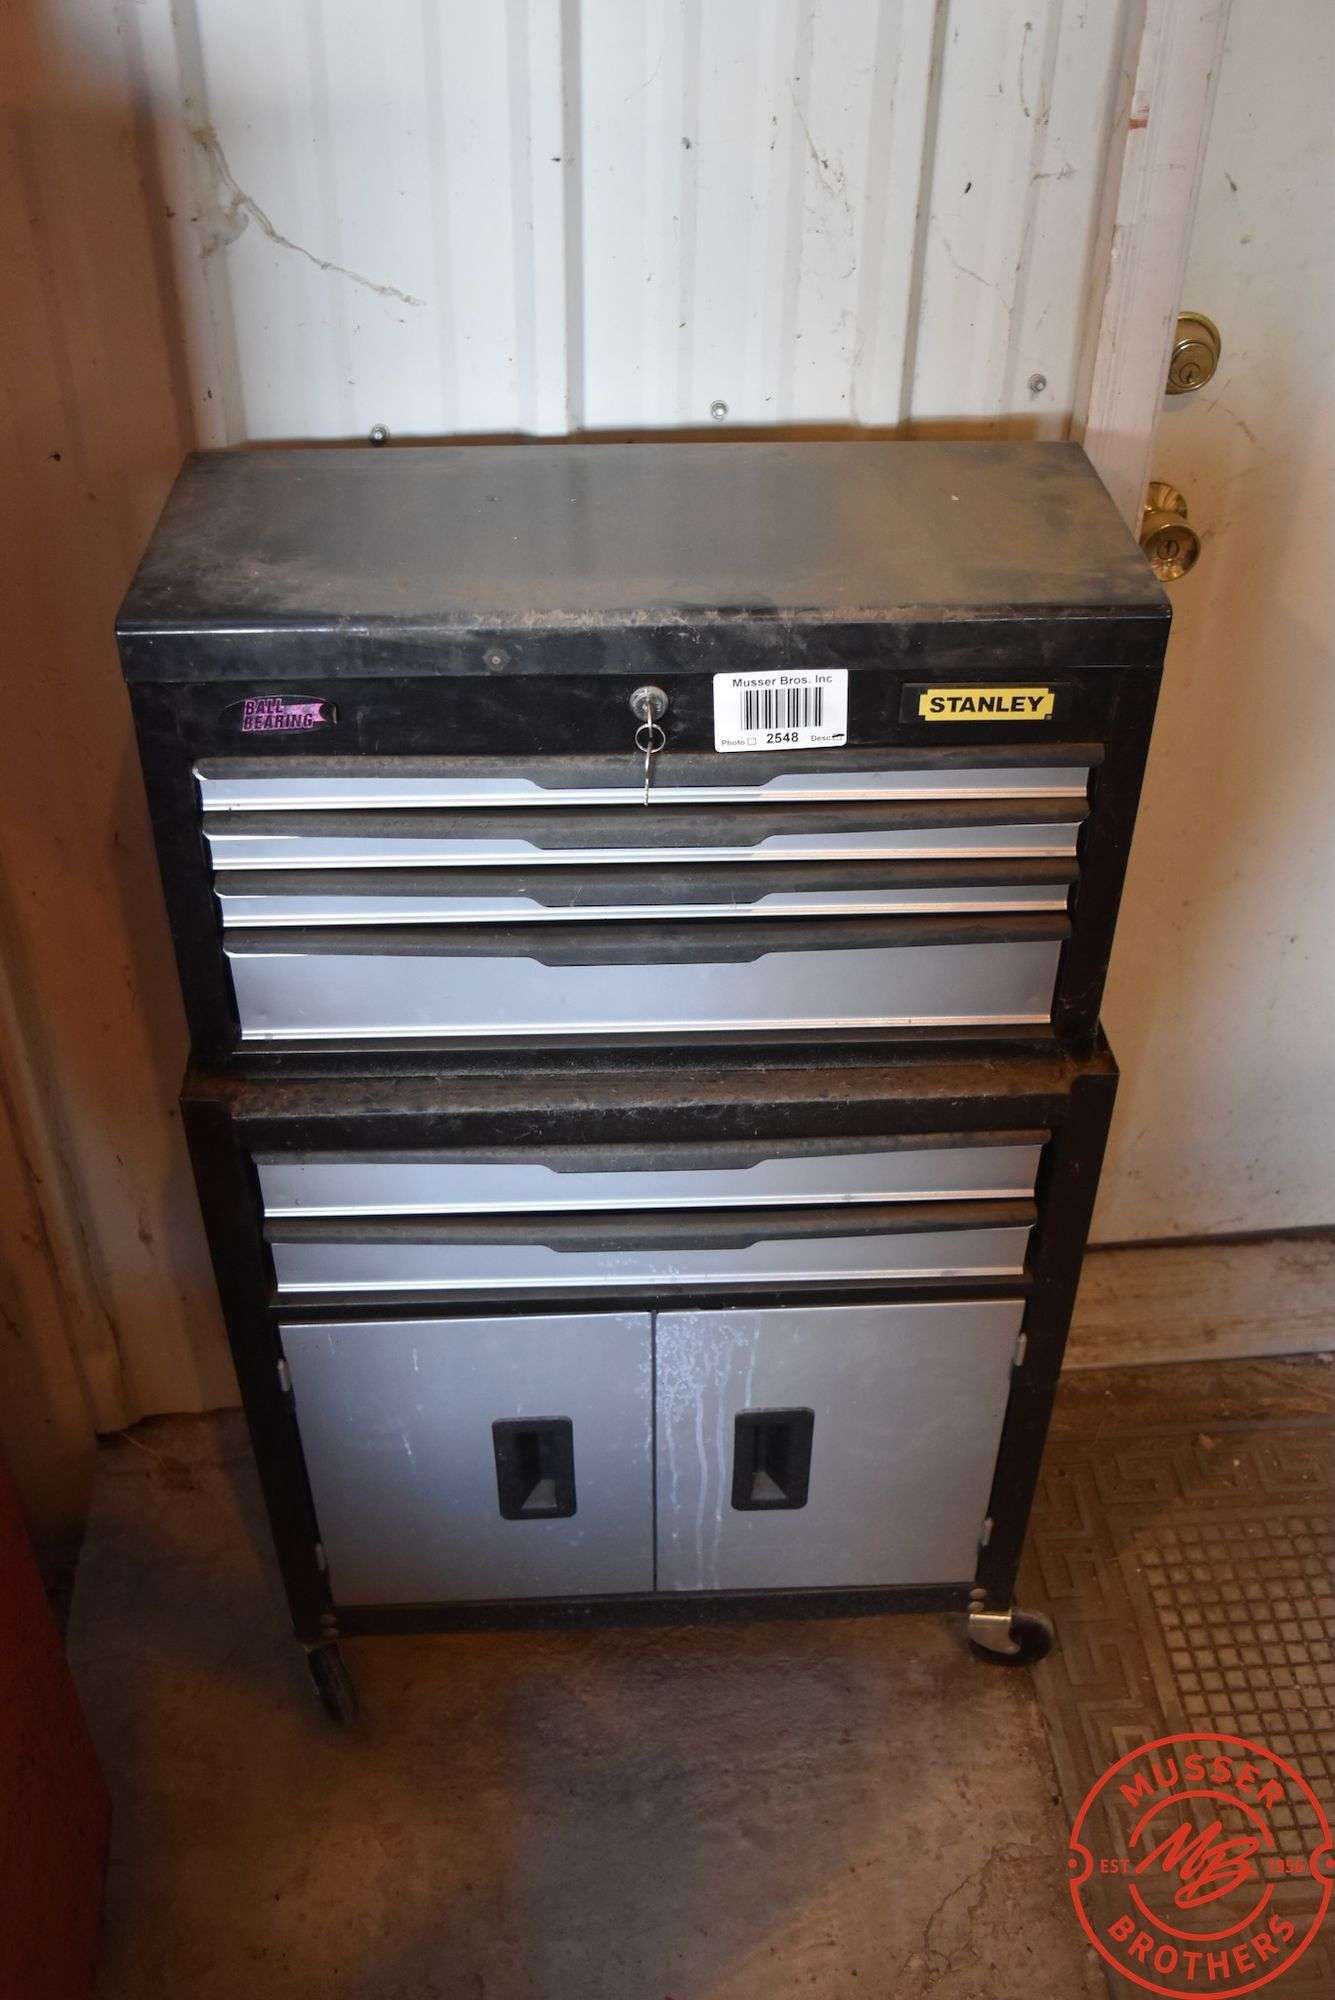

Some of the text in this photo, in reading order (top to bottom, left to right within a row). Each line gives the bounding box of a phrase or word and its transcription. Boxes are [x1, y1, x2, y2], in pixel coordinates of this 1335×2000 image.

[732, 674, 833, 687] Musser Bros. Inc
[244, 698, 283, 715] BALL
[930, 696, 1044, 713] STANLEY
[242, 713, 315, 731] BEARING
[766, 732, 799, 744] 2548
